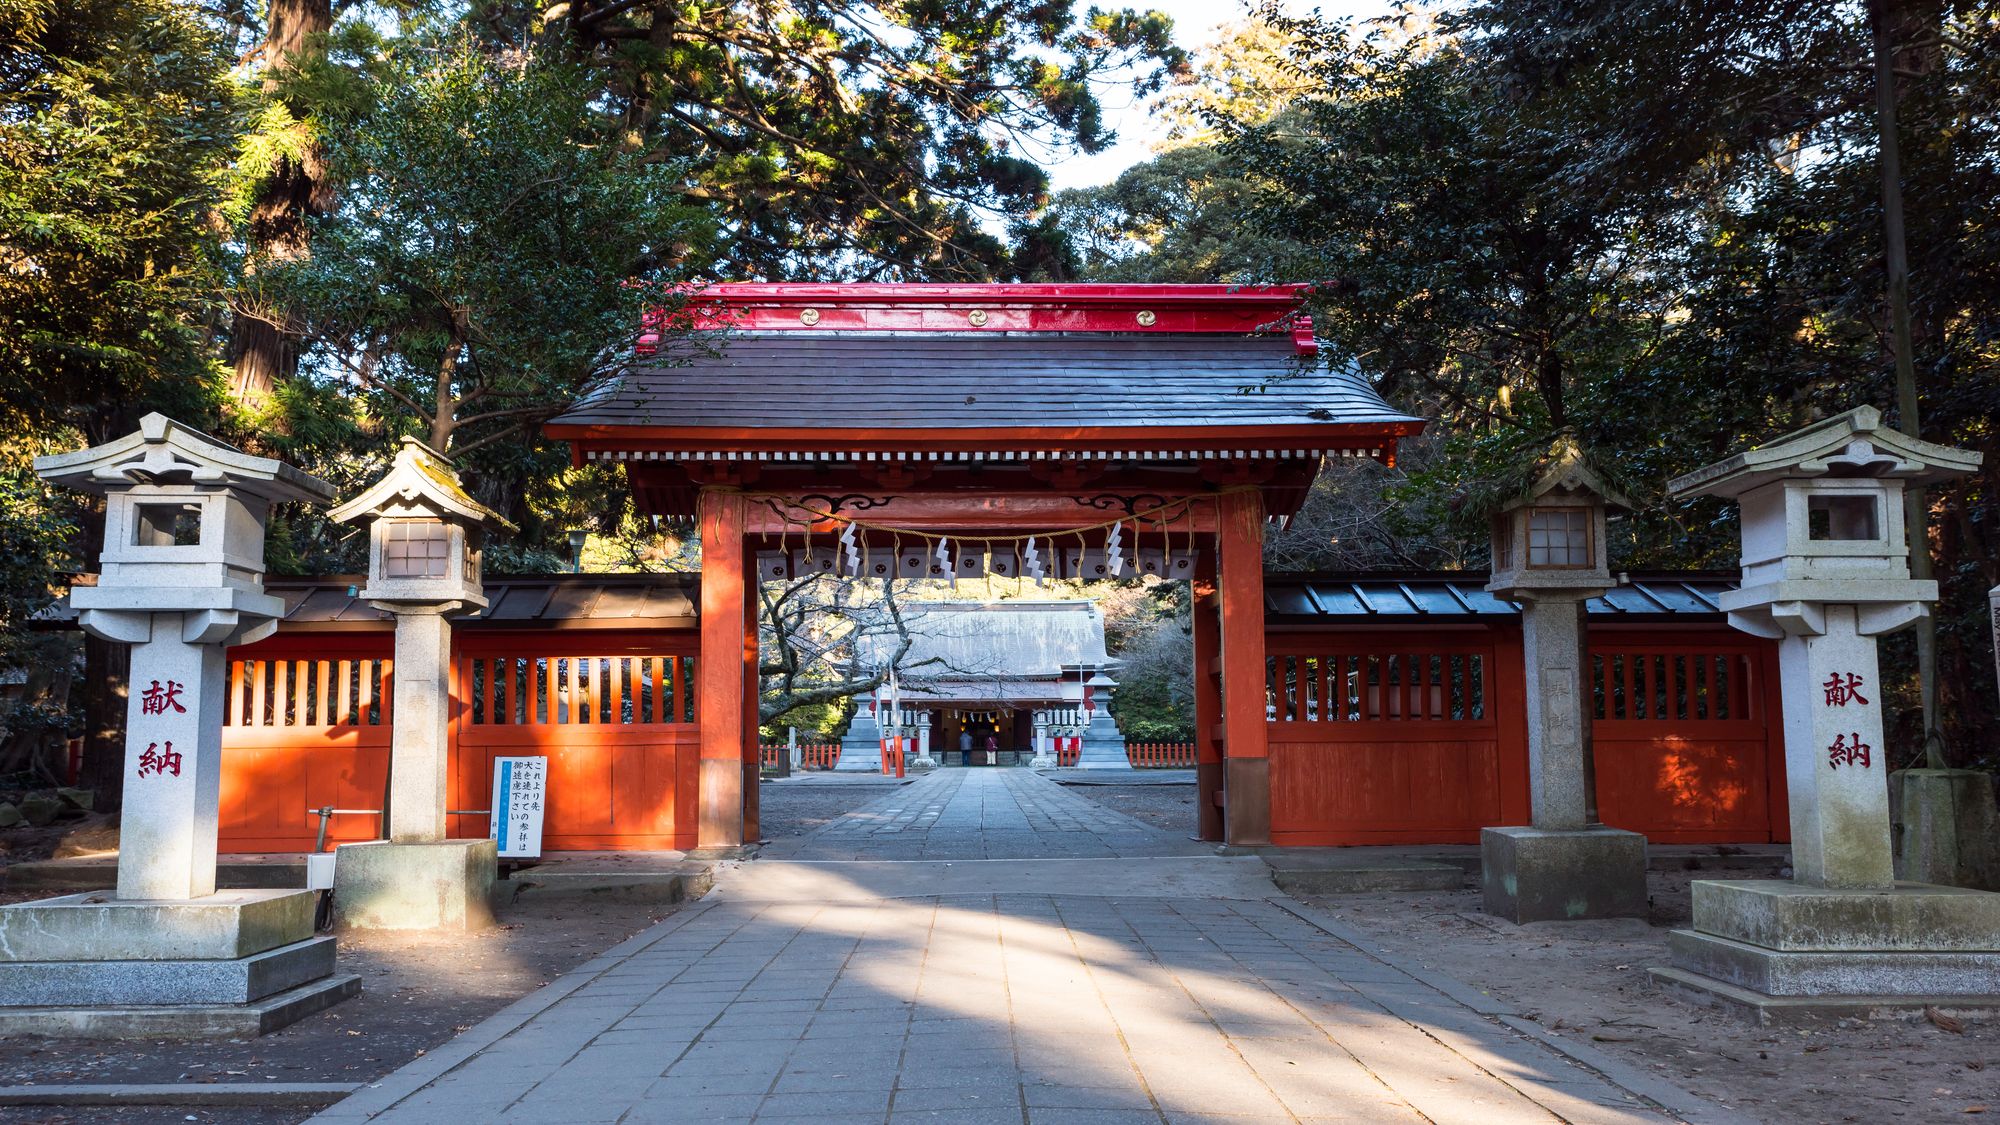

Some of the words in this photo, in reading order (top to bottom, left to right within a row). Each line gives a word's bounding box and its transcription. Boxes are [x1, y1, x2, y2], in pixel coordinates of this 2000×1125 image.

[138, 680, 187, 779] 献納
[1823, 672, 1871, 770] 献納
[510, 761, 523, 820] 御遠慮下さい
[518, 761, 533, 851] 犬を連れての参拝は
[530, 762, 541, 811] これより先
